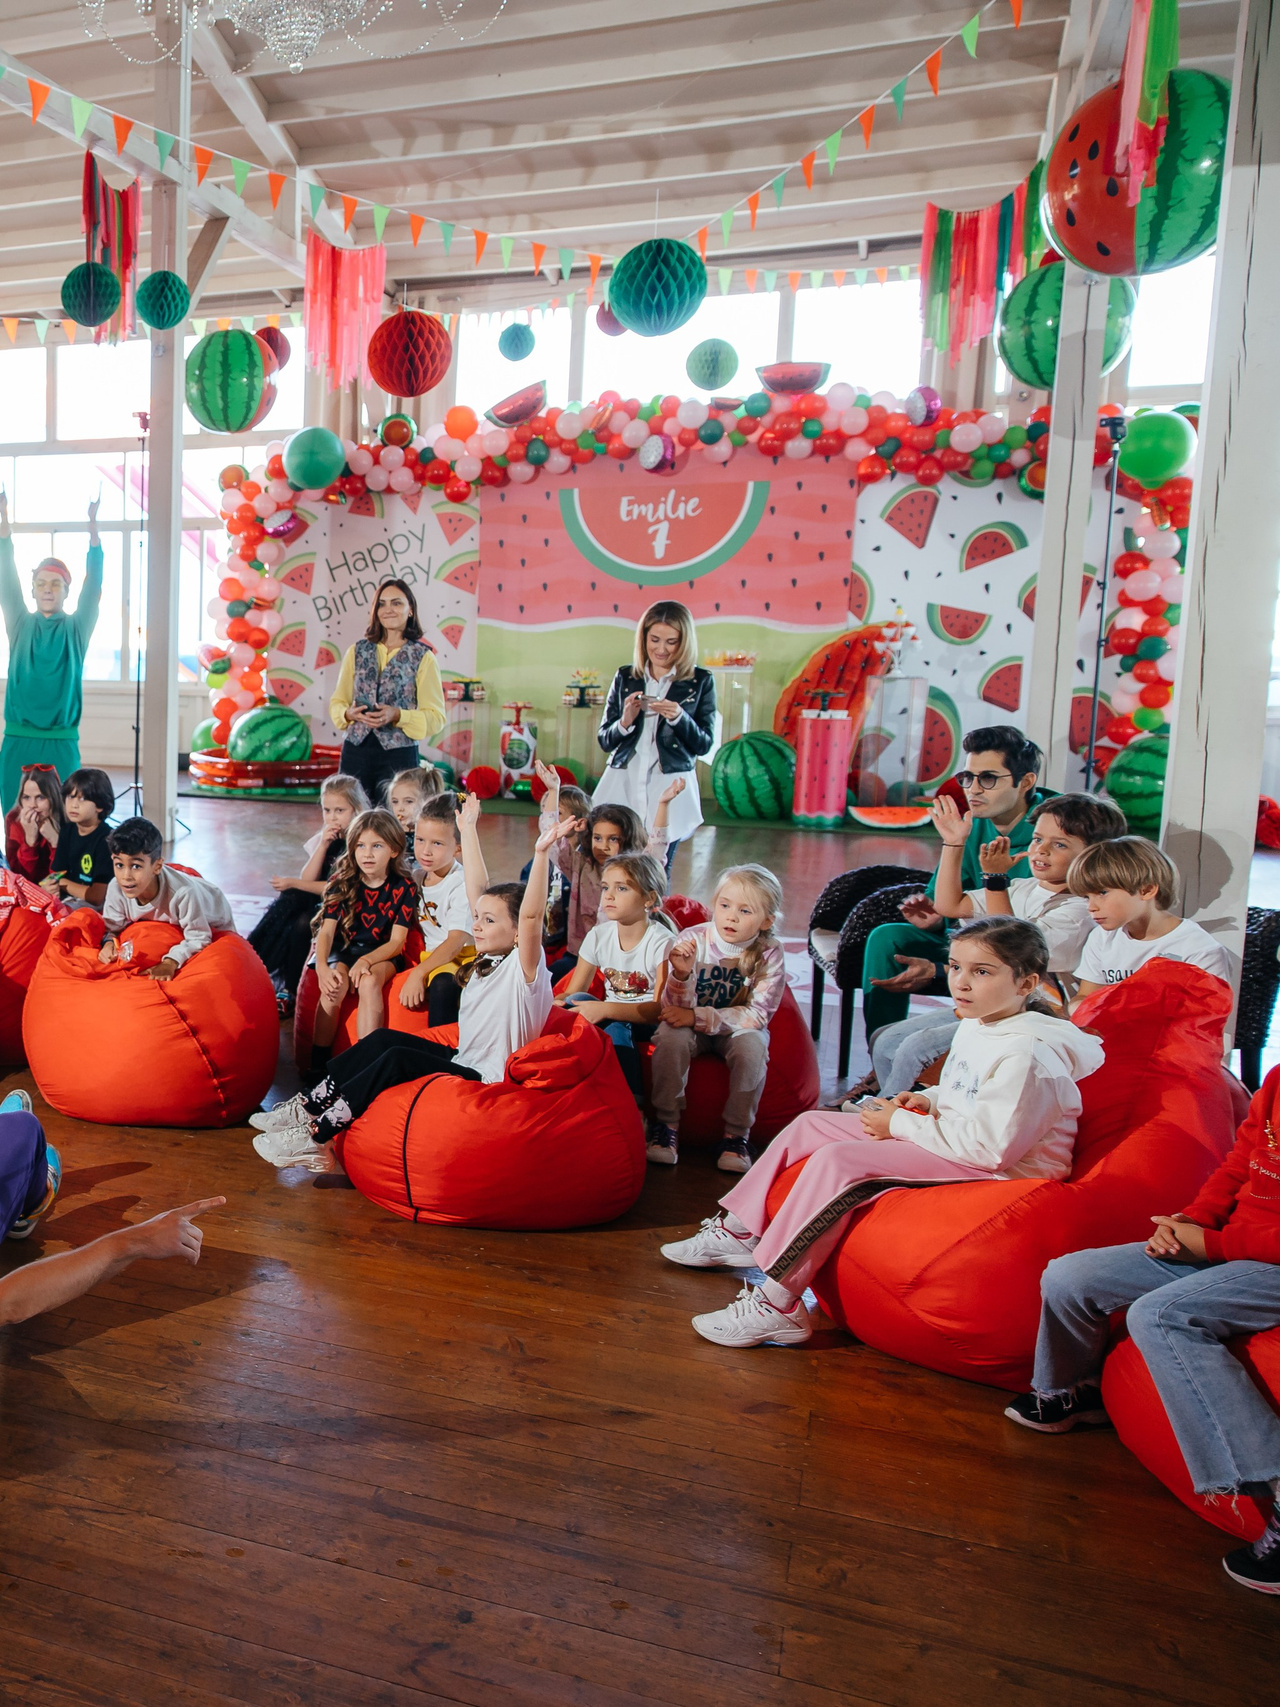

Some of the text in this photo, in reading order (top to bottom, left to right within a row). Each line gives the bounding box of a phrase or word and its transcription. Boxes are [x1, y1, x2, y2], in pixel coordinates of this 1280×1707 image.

[620, 488, 702, 523] Emilie
[325, 523, 426, 583] Happy
[647, 520, 671, 560] 7
[697, 965, 744, 985] LOVE
